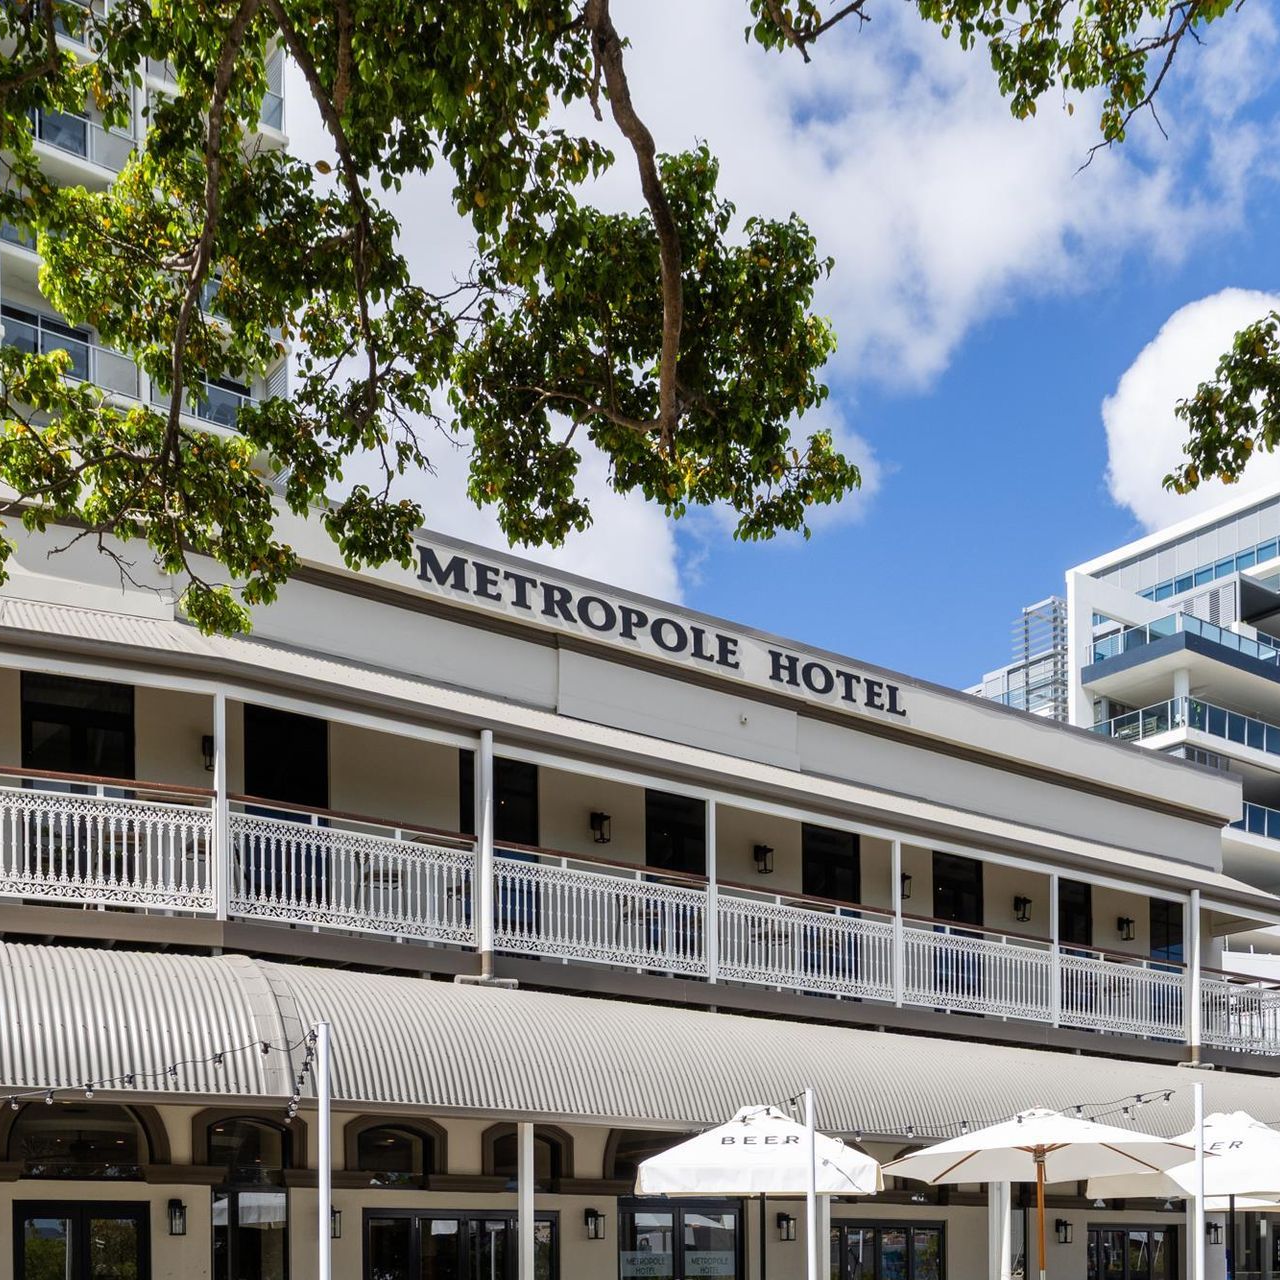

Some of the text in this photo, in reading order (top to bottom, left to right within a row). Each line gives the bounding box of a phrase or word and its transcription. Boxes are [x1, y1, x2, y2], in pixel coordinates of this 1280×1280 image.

[416, 545, 907, 717] METROPOLE HOTEL
[721, 1135, 800, 1145] BEER
[625, 1257, 665, 1266] METROPOLE
[691, 1257, 729, 1265] METROPOLE
[635, 1266, 657, 1275] HOTEL
